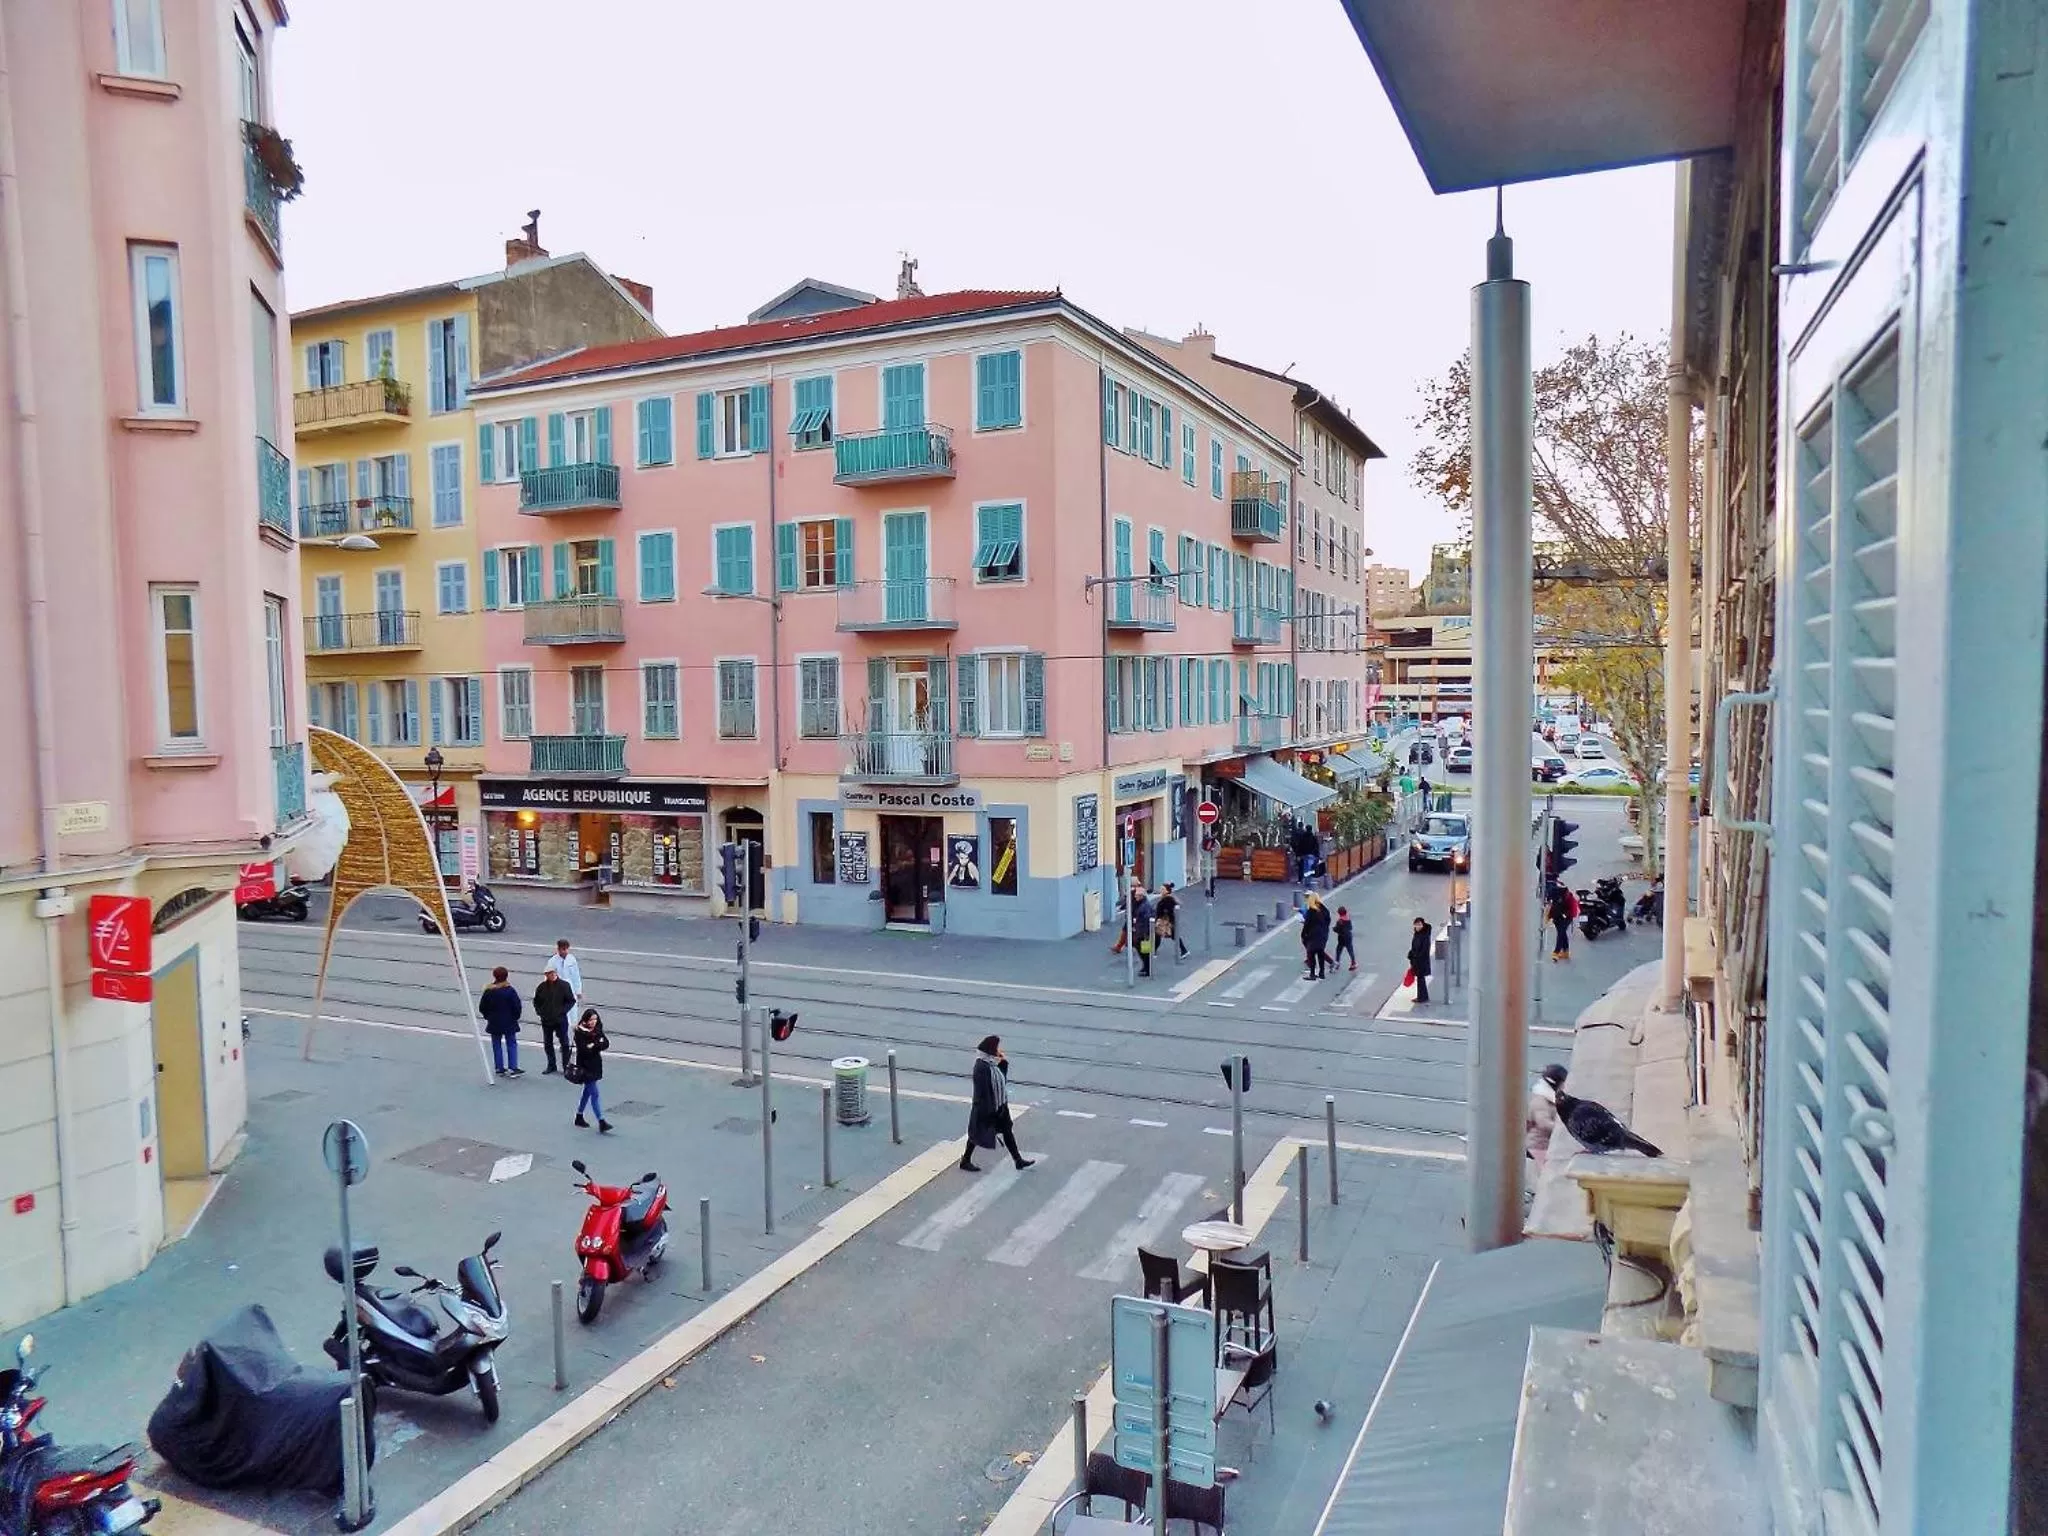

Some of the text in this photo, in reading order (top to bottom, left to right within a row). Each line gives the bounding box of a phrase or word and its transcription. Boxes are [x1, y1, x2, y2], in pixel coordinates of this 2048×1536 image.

[522, 788, 652, 804] AGENCE REPUBLIQUE
[878, 792, 925, 806] Pascal
[930, 793, 976, 807] Coste
